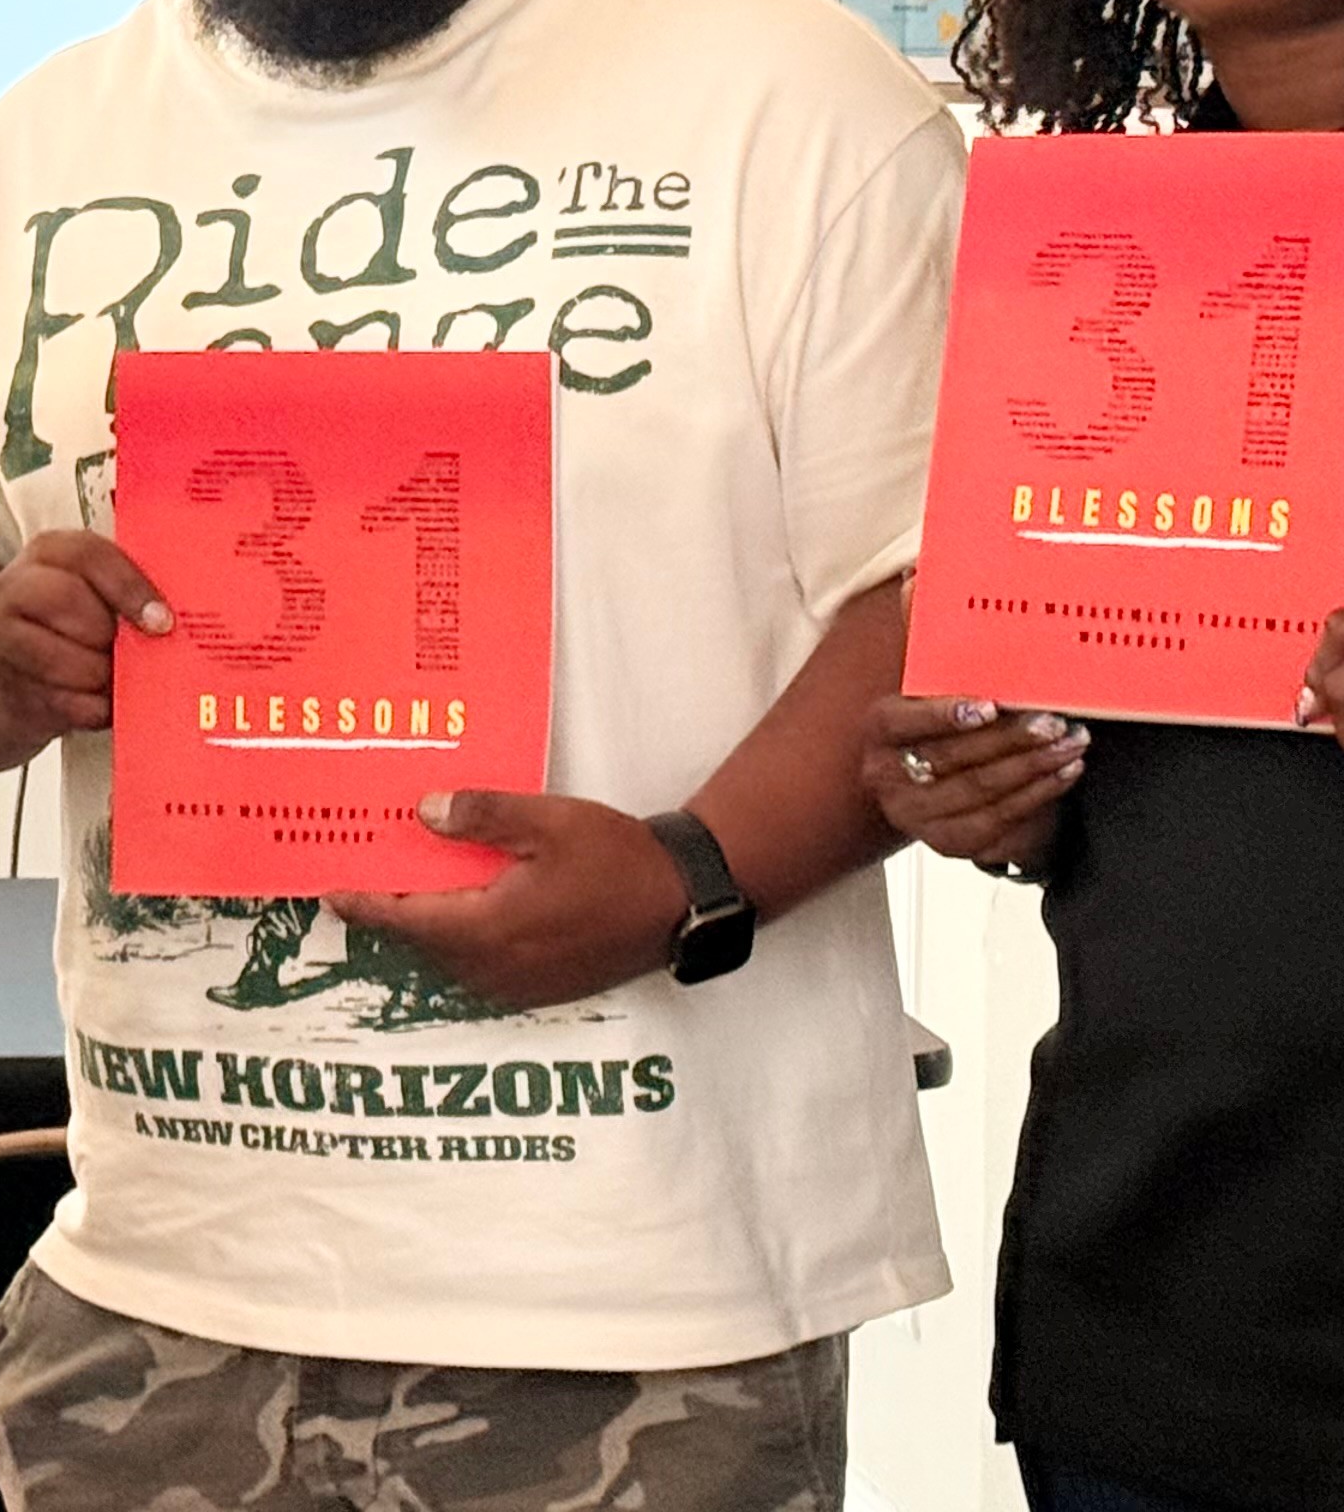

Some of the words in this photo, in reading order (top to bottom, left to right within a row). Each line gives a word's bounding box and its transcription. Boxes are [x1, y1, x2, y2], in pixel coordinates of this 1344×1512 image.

[558, 161, 692, 215] The
[1006, 231, 1312, 468] 31
[1012, 485, 1291, 538] BLESSONS
[178, 449, 461, 671] 31
[198, 694, 466, 736] BLESSONS
[76, 1030, 203, 1102] NEW
[215, 1052, 677, 1119] HORIZONS
[134, 1112, 151, 1138] A
[153, 1116, 235, 1148] NEW
[239, 1122, 432, 1162] CHAPTER
[437, 1133, 577, 1163] RIDES
